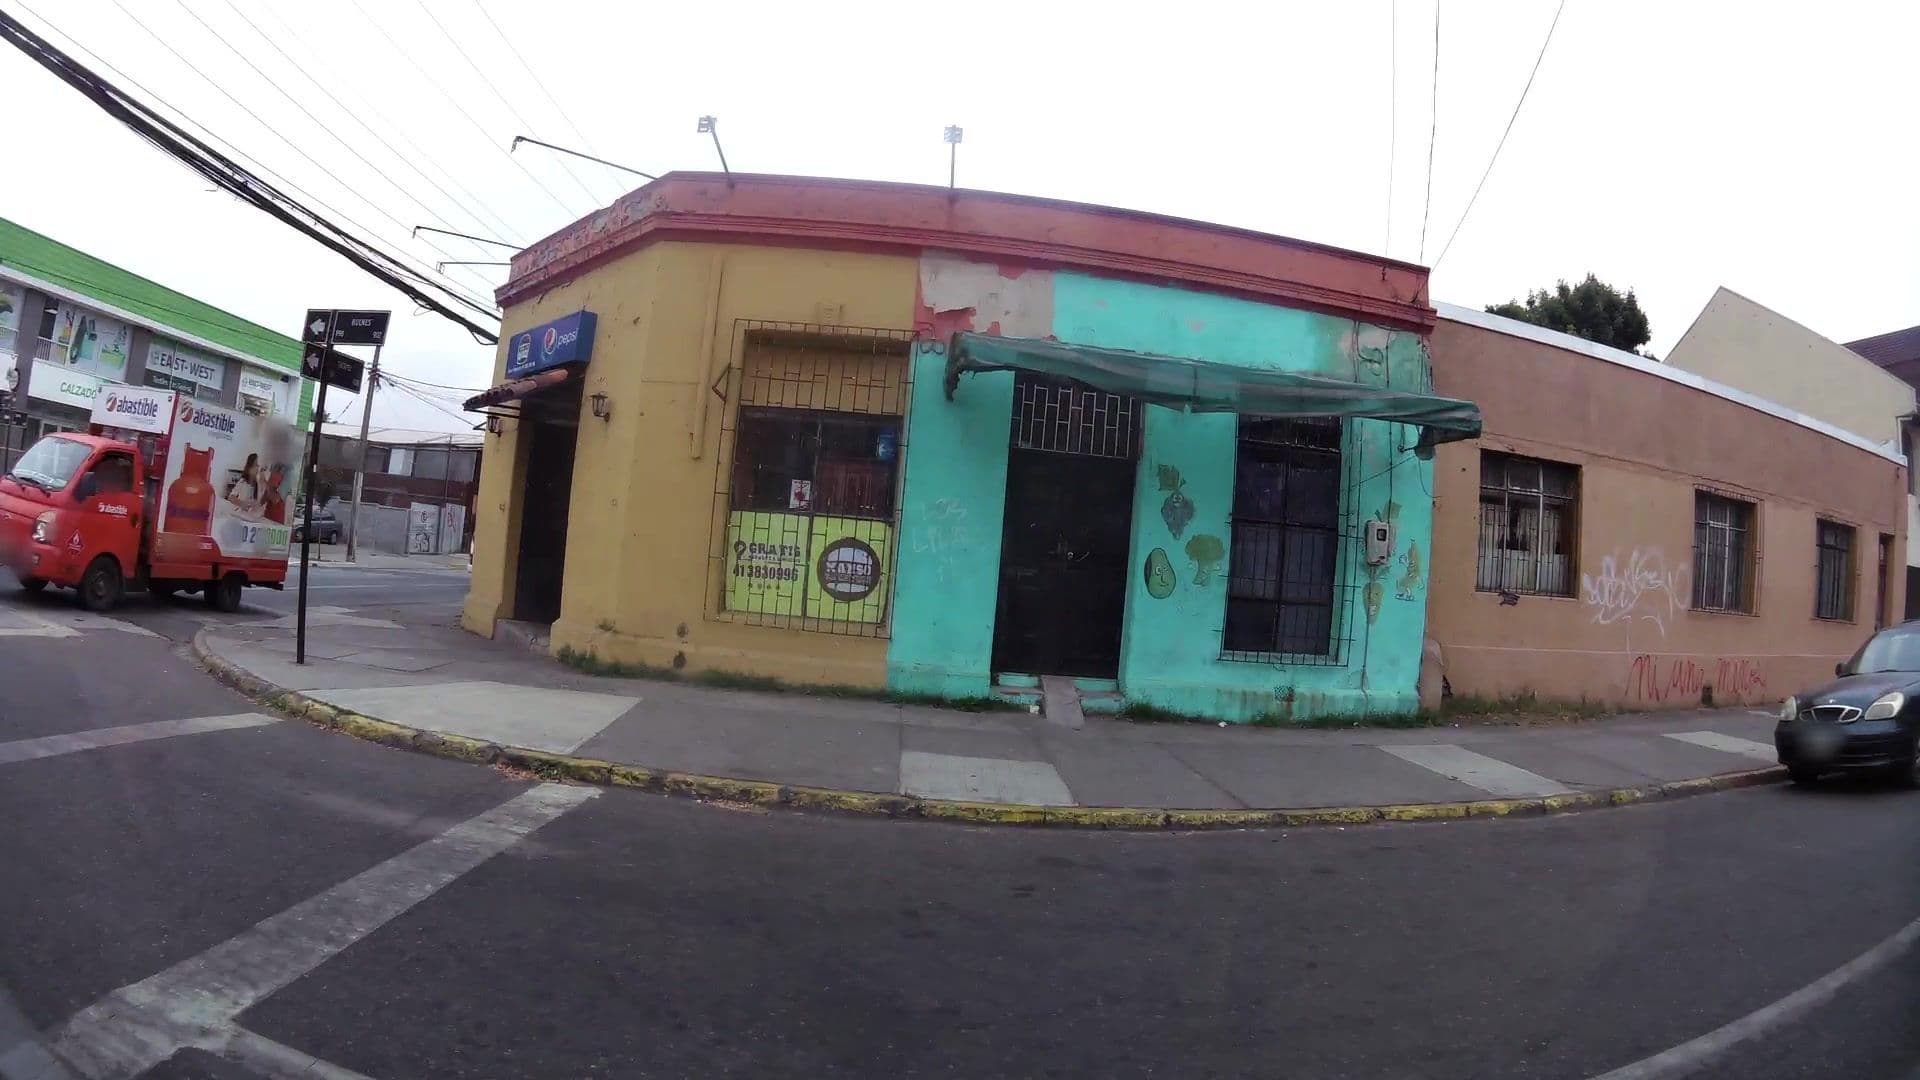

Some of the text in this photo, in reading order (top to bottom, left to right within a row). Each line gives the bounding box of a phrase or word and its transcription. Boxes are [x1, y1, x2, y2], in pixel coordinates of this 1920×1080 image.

[557, 328, 580, 349] pepsi
[160, 353, 216, 381] EAST-WEST
[116, 396, 159, 417] abastible
[192, 408, 236, 434] abastible
